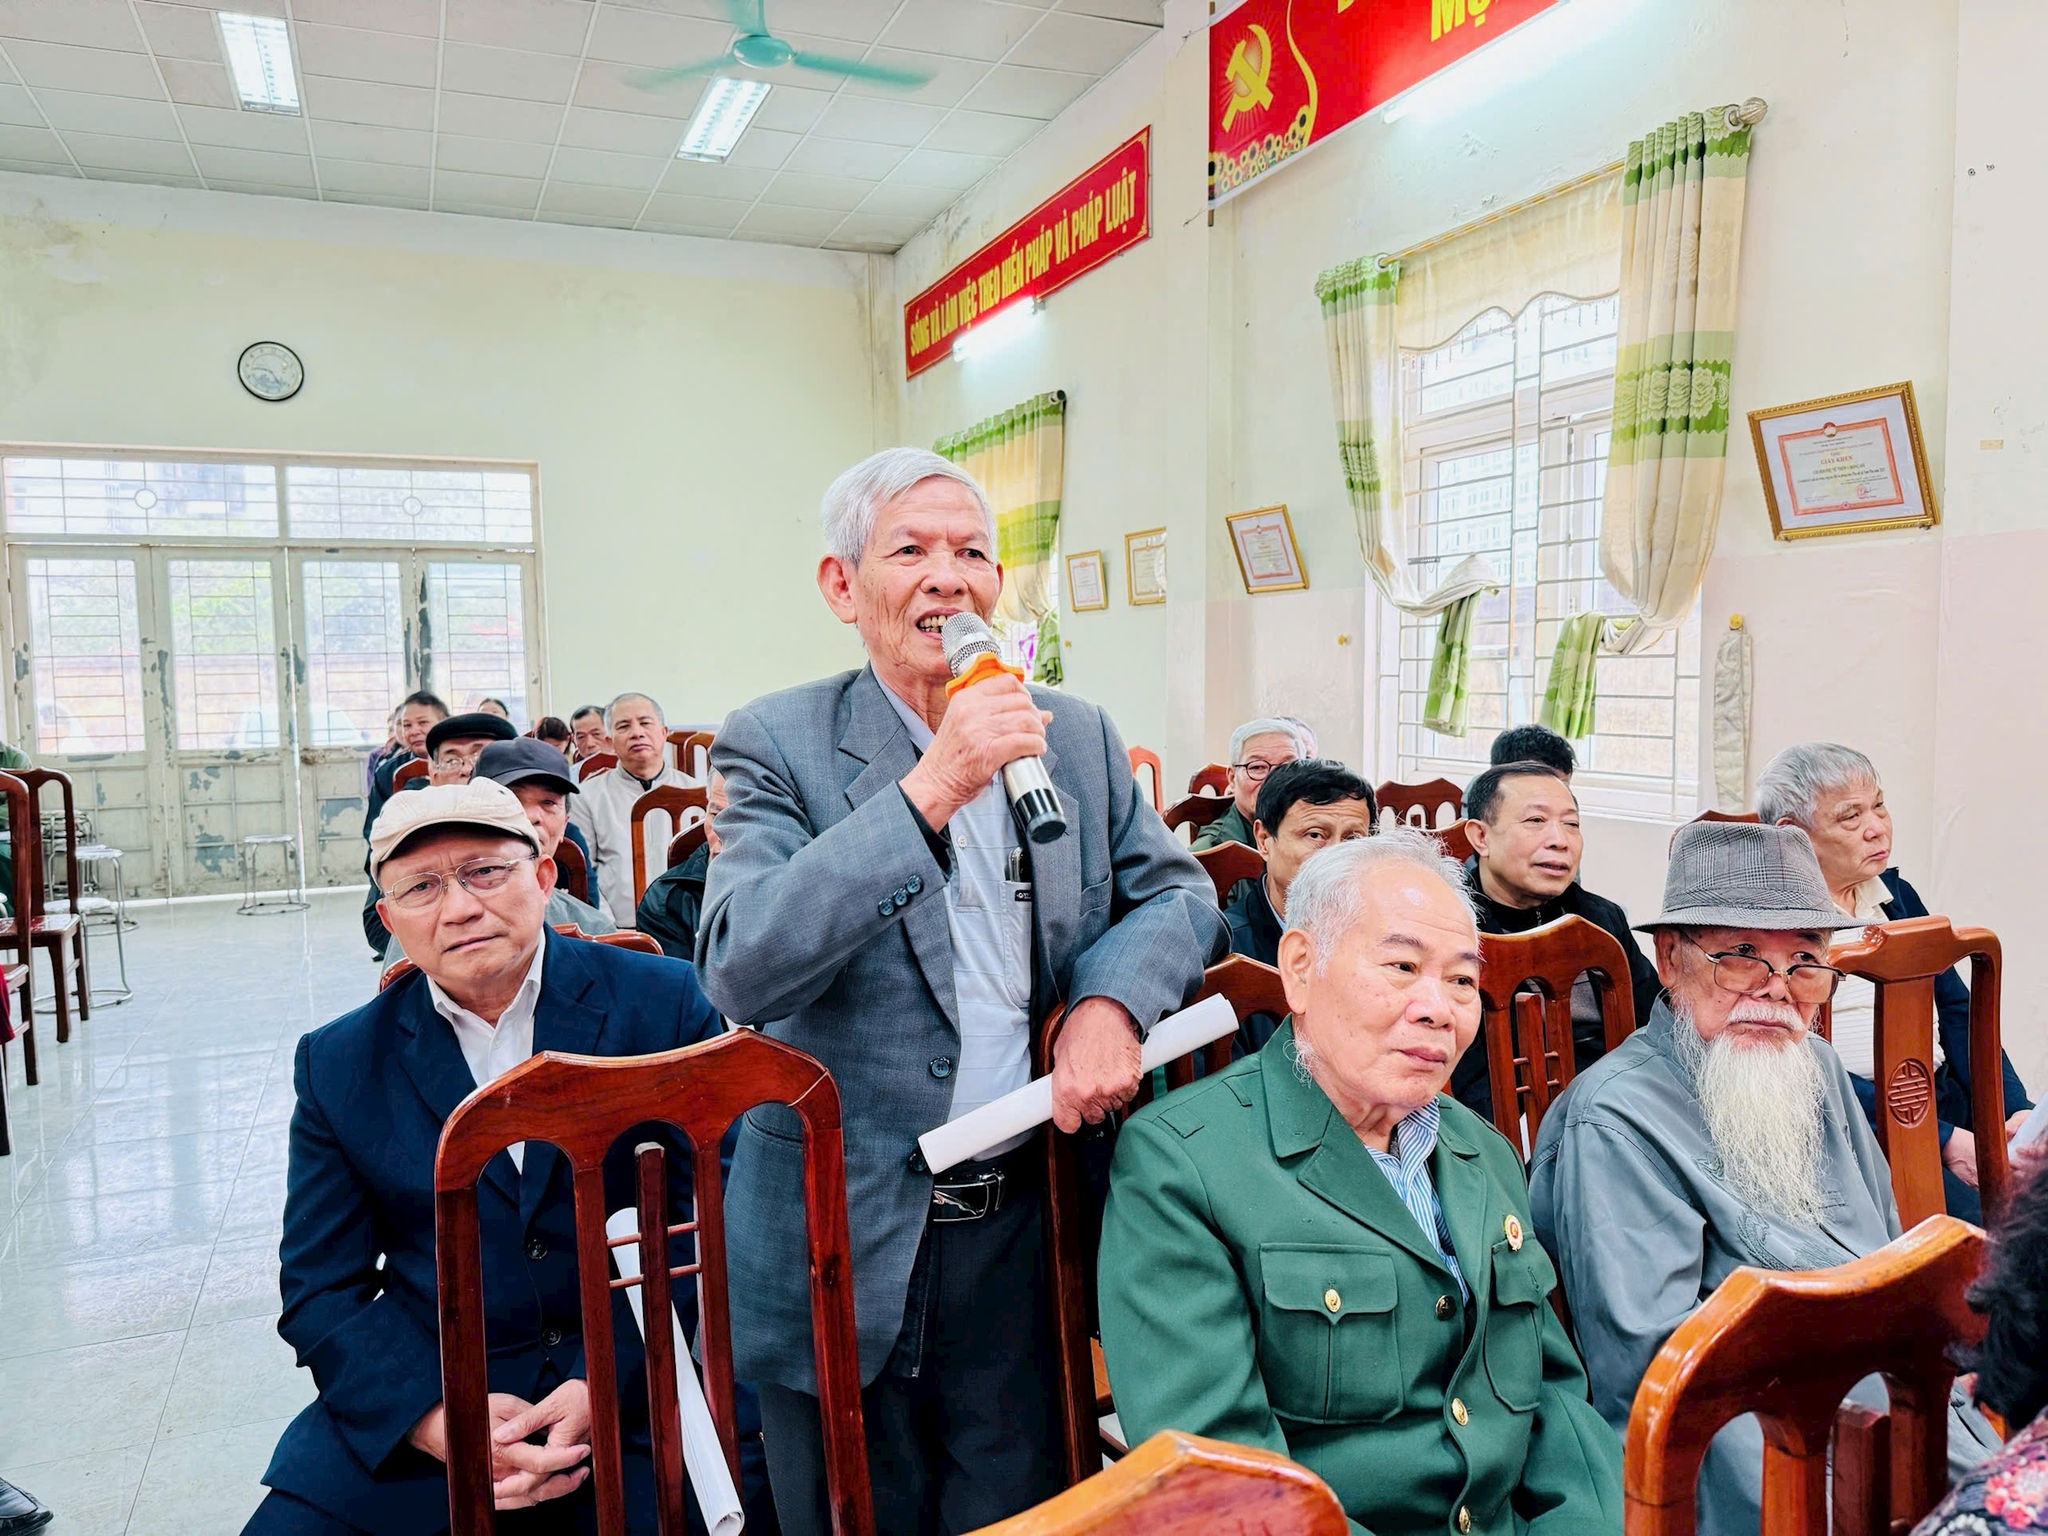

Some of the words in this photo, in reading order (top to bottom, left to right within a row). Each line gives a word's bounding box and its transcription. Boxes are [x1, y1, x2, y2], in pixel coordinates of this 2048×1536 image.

[911, 309, 929, 357] SỐNG
[930, 301, 941, 344] VÀ
[941, 293, 958, 338] LÀM
[958, 277, 977, 330] VIỆC
[978, 265, 1000, 314] THEO
[1001, 239, 1024, 299] HIẾN
[1025, 224, 1053, 284] PHÁP
[1055, 208, 1069, 265] VÀ
[1071, 190, 1103, 255] PHÁP
[1105, 166, 1137, 234] LUẬT
